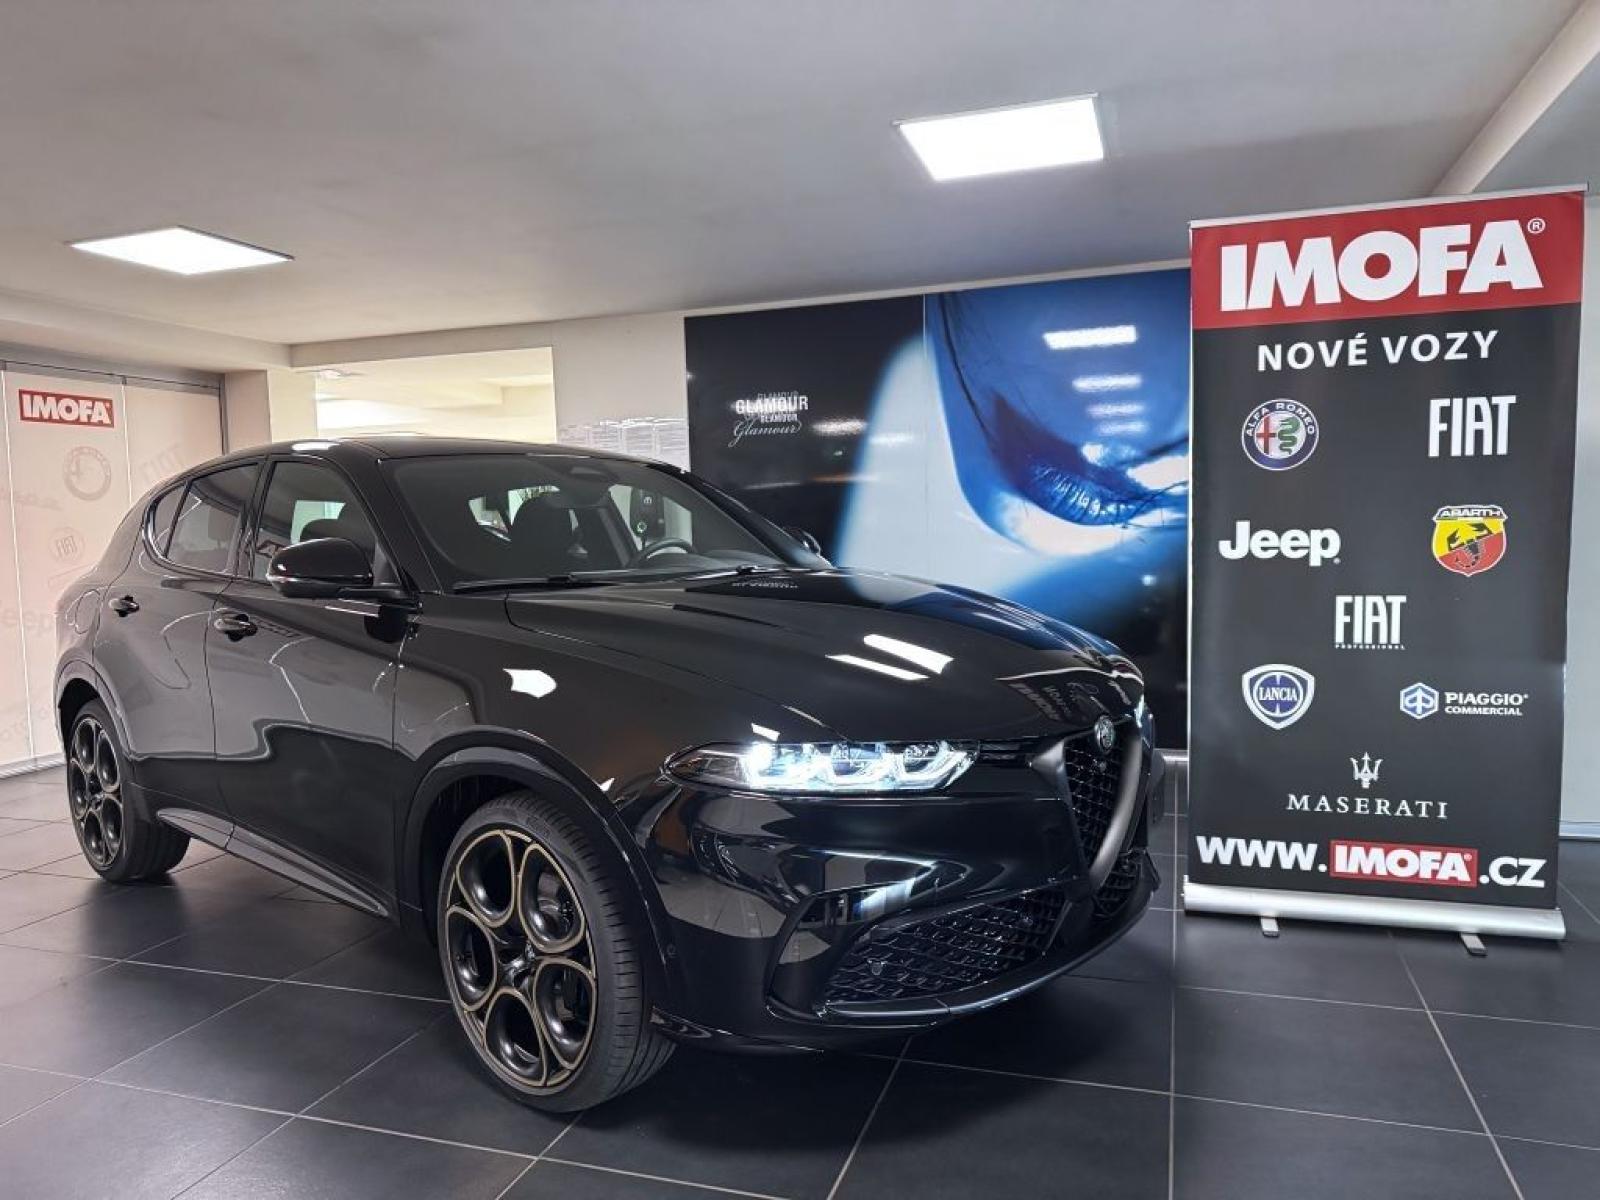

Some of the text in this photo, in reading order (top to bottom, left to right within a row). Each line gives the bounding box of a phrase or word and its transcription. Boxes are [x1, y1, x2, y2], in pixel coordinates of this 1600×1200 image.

[1257, 330, 1499, 372] NOVÉ VOZY
[735, 394, 809, 414] GLAMOUR
[1246, 402, 1315, 437] ALFA ROMEO
[1428, 395, 1517, 457] FIAT
[1440, 507, 1502, 518] ABARTH
[1218, 520, 1341, 567] Jeep
[1335, 594, 1408, 645] FIAT
[1259, 686, 1298, 702] LANCIA
[1444, 691, 1524, 706] PIAGGIO
[1444, 705, 1523, 717] COMMERCIAL
[1286, 793, 1449, 819] MASERATI
